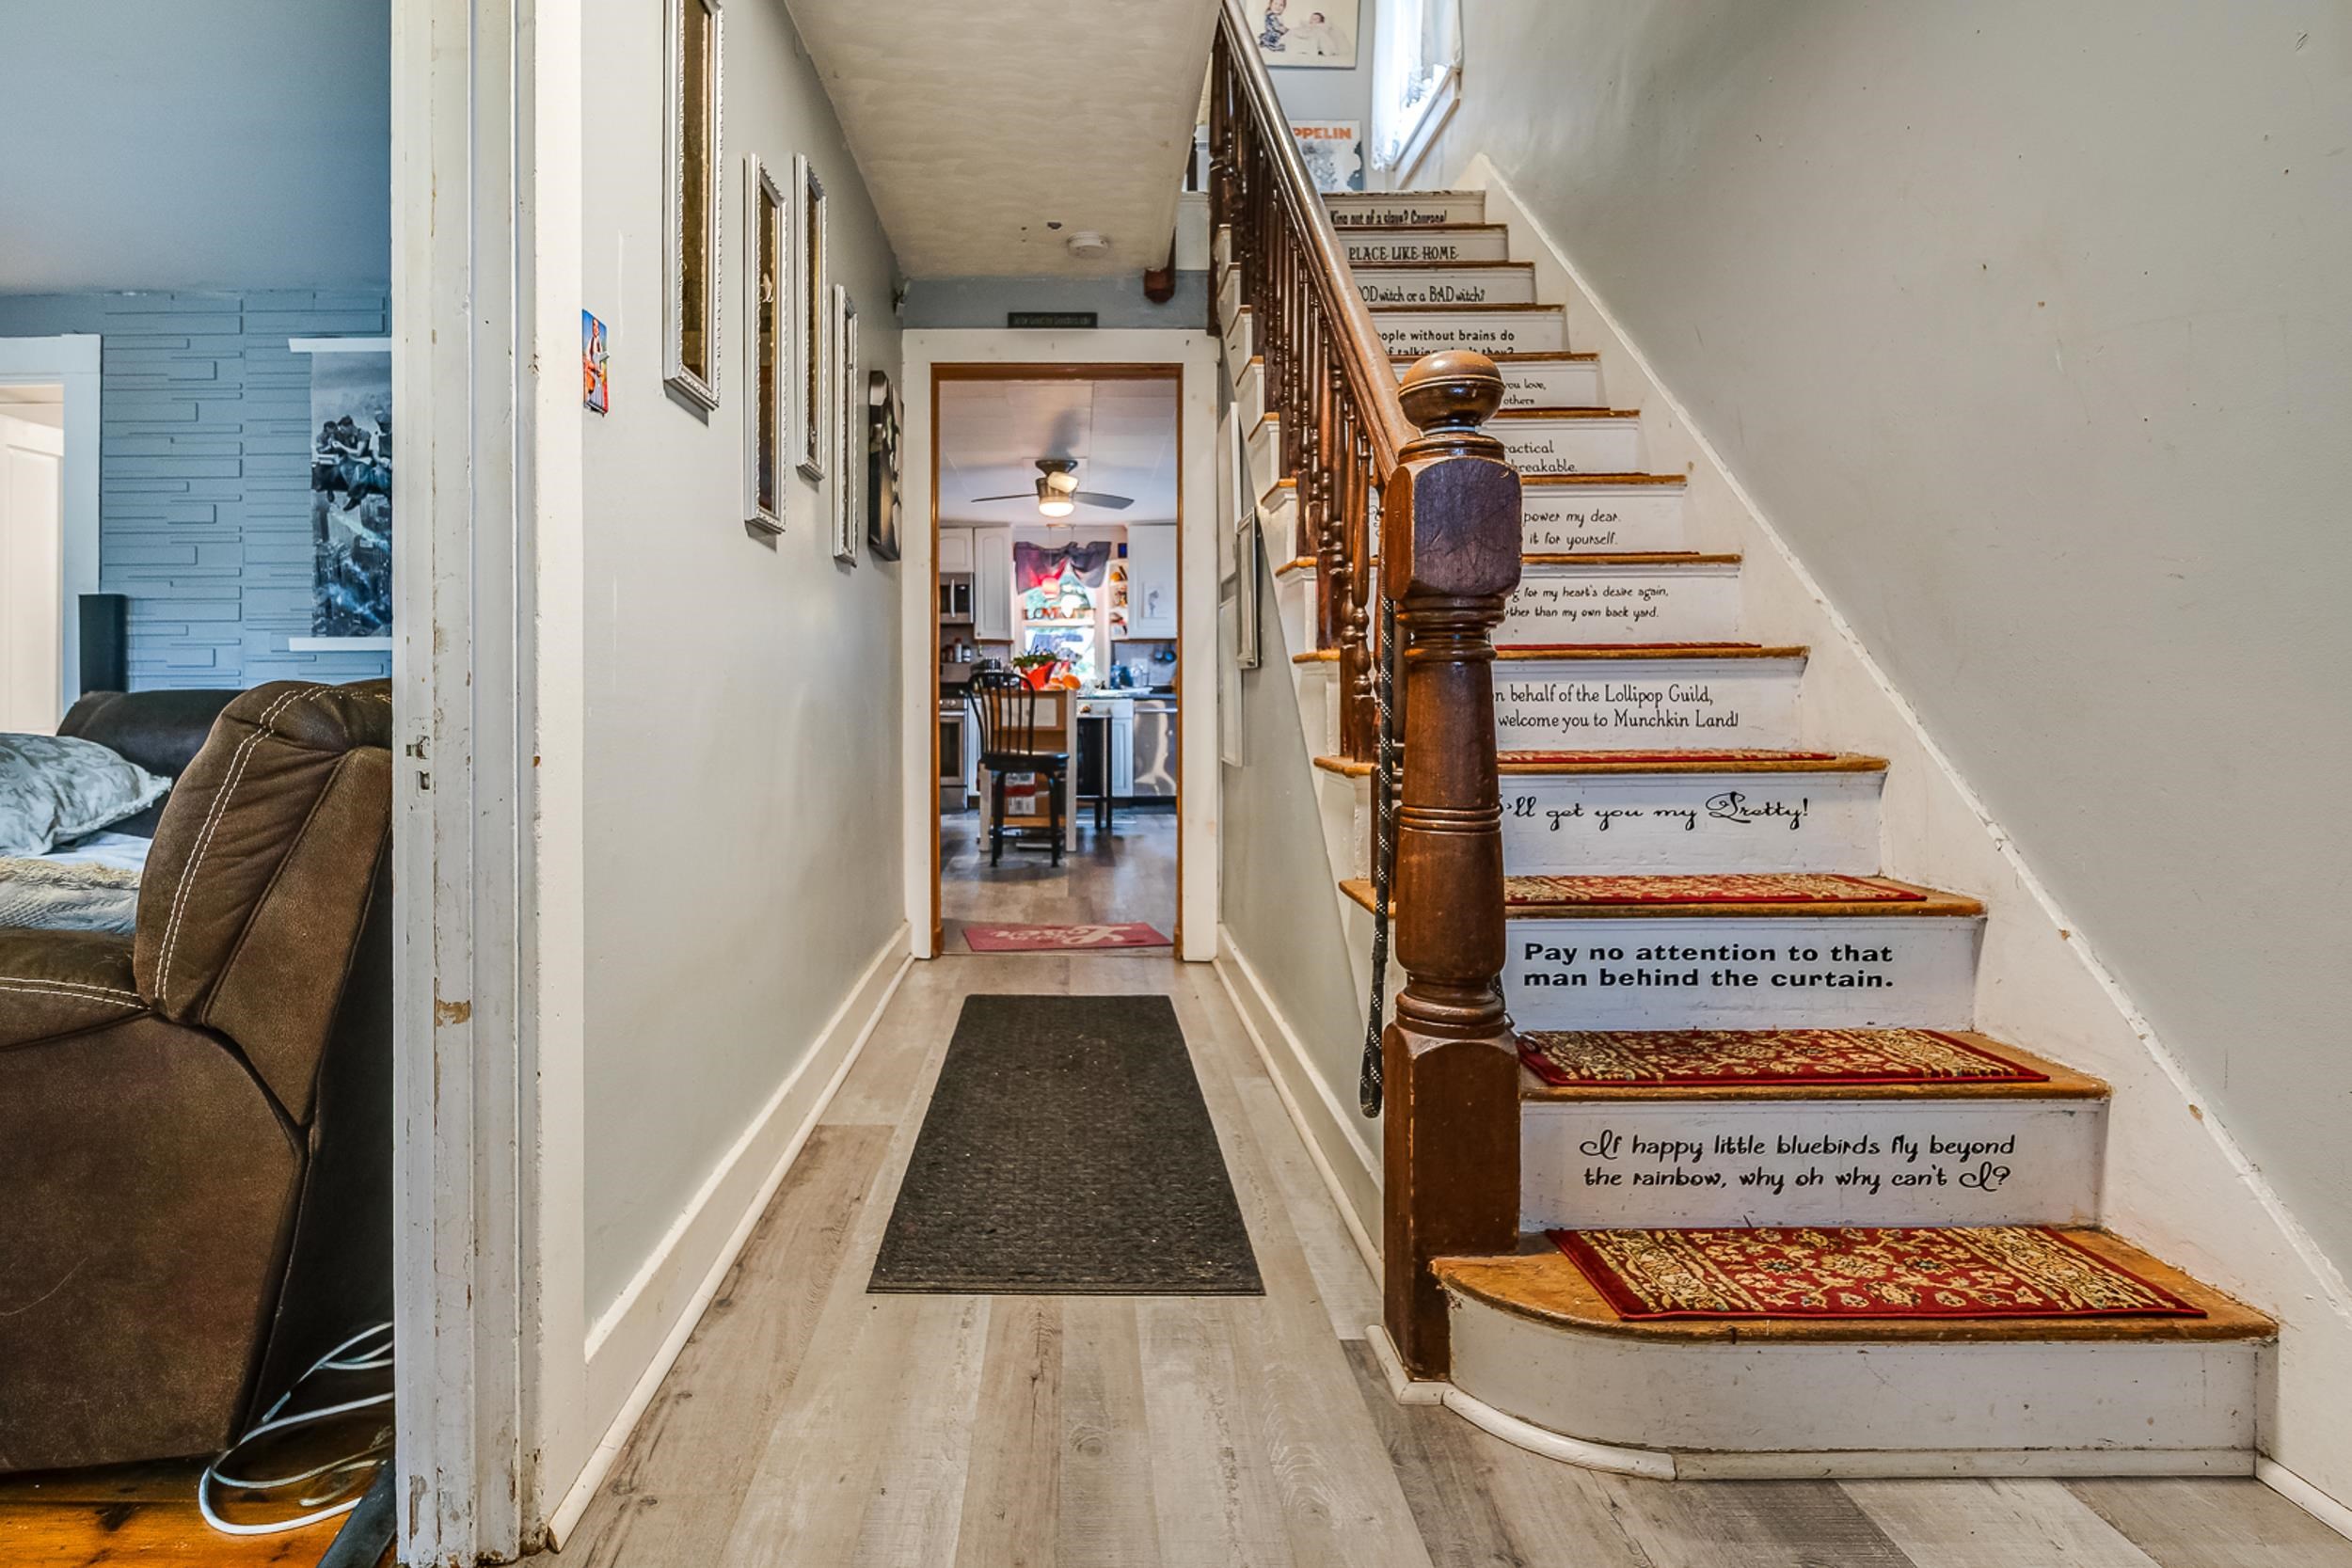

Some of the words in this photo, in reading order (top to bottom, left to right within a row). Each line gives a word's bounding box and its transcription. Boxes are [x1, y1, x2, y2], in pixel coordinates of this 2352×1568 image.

[1348, 246, 1388, 261] PLACE
[1391, 246, 1419, 261] LIKE
[1422, 246, 1459, 261] HOME
[1379, 286, 1405, 302] witch
[1406, 291, 1418, 301] or
[1420, 292, 1426, 301] a
[1429, 285, 1454, 302] BAD
[1455, 285, 1486, 302] witch?
[1377, 329, 1406, 345] ople
[1410, 329, 1454, 341] without
[1458, 329, 1496, 341] brains
[1500, 329, 1515, 341] do
[1384, 346, 1394, 355] f
[1523, 377, 1547, 391] love,
[1523, 512, 1561, 527] power
[1565, 513, 1585, 528] my
[1590, 508, 1622, 522] dear.
[1529, 531, 1539, 545] it
[1544, 531, 1561, 545] for
[1565, 531, 1618, 550] yourself.
[1523, 587, 1538, 598] for
[1542, 590, 1558, 602] my
[1562, 584, 1598, 597] heart's
[1602, 586, 1633, 597] desire
[1637, 585, 1669, 602] again,
[1534, 606, 1558, 617] than
[1562, 609, 1577, 622] my
[1605, 606, 1629, 617] back
[1632, 607, 1660, 622] yard.
[1492, 690, 1505, 703] n
[1511, 684, 1557, 703] behalf
[1558, 684, 1575, 703] of
[1576, 686, 1599, 703] the
[1605, 684, 1663, 708] Lollipop
[1668, 684, 1714, 705] Guild,
[1498, 709, 1559, 727] welcome
[1562, 716, 1590, 734] you
[1594, 712, 1608, 727] to
[1613, 708, 1689, 727] Munchkin
[1695, 709, 1739, 727] Land!
[1500, 795, 1537, 817] 'll
[1546, 802, 1585, 832] get
[1594, 807, 1645, 832] you
[1653, 807, 1697, 832] my
[1705, 791, 1809, 832] Pretty!
[1524, 943, 1579, 965] Pay
[1589, 946, 1625, 962] no
[1635, 943, 1776, 962] attention
[1788, 945, 1819, 962] to
[1830, 944, 1894, 962] that
[1523, 972, 1587, 987] man
[1599, 969, 1699, 987] behind
[1709, 969, 1759, 987] the
[1771, 970, 1894, 988] curtain.
[1579, 1130, 1625, 1159] If
[1631, 1134, 1705, 1163] happy
[1714, 1135, 1766, 1155] little
[1776, 1134, 1882, 1155] bluebirds
[1891, 1134, 1919, 1163] fly
[1929, 1134, 2015, 1163] beyond
[1583, 1167, 1623, 1187] the
[1633, 1167, 1727, 1190] rainbow,
[1739, 1167, 1786, 1195] why
[1795, 1167, 1824, 1187] oh
[1835, 1167, 1882, 1195] why
[1892, 1164, 1948, 1187] can't
[1958, 1162, 2011, 1192] I?
